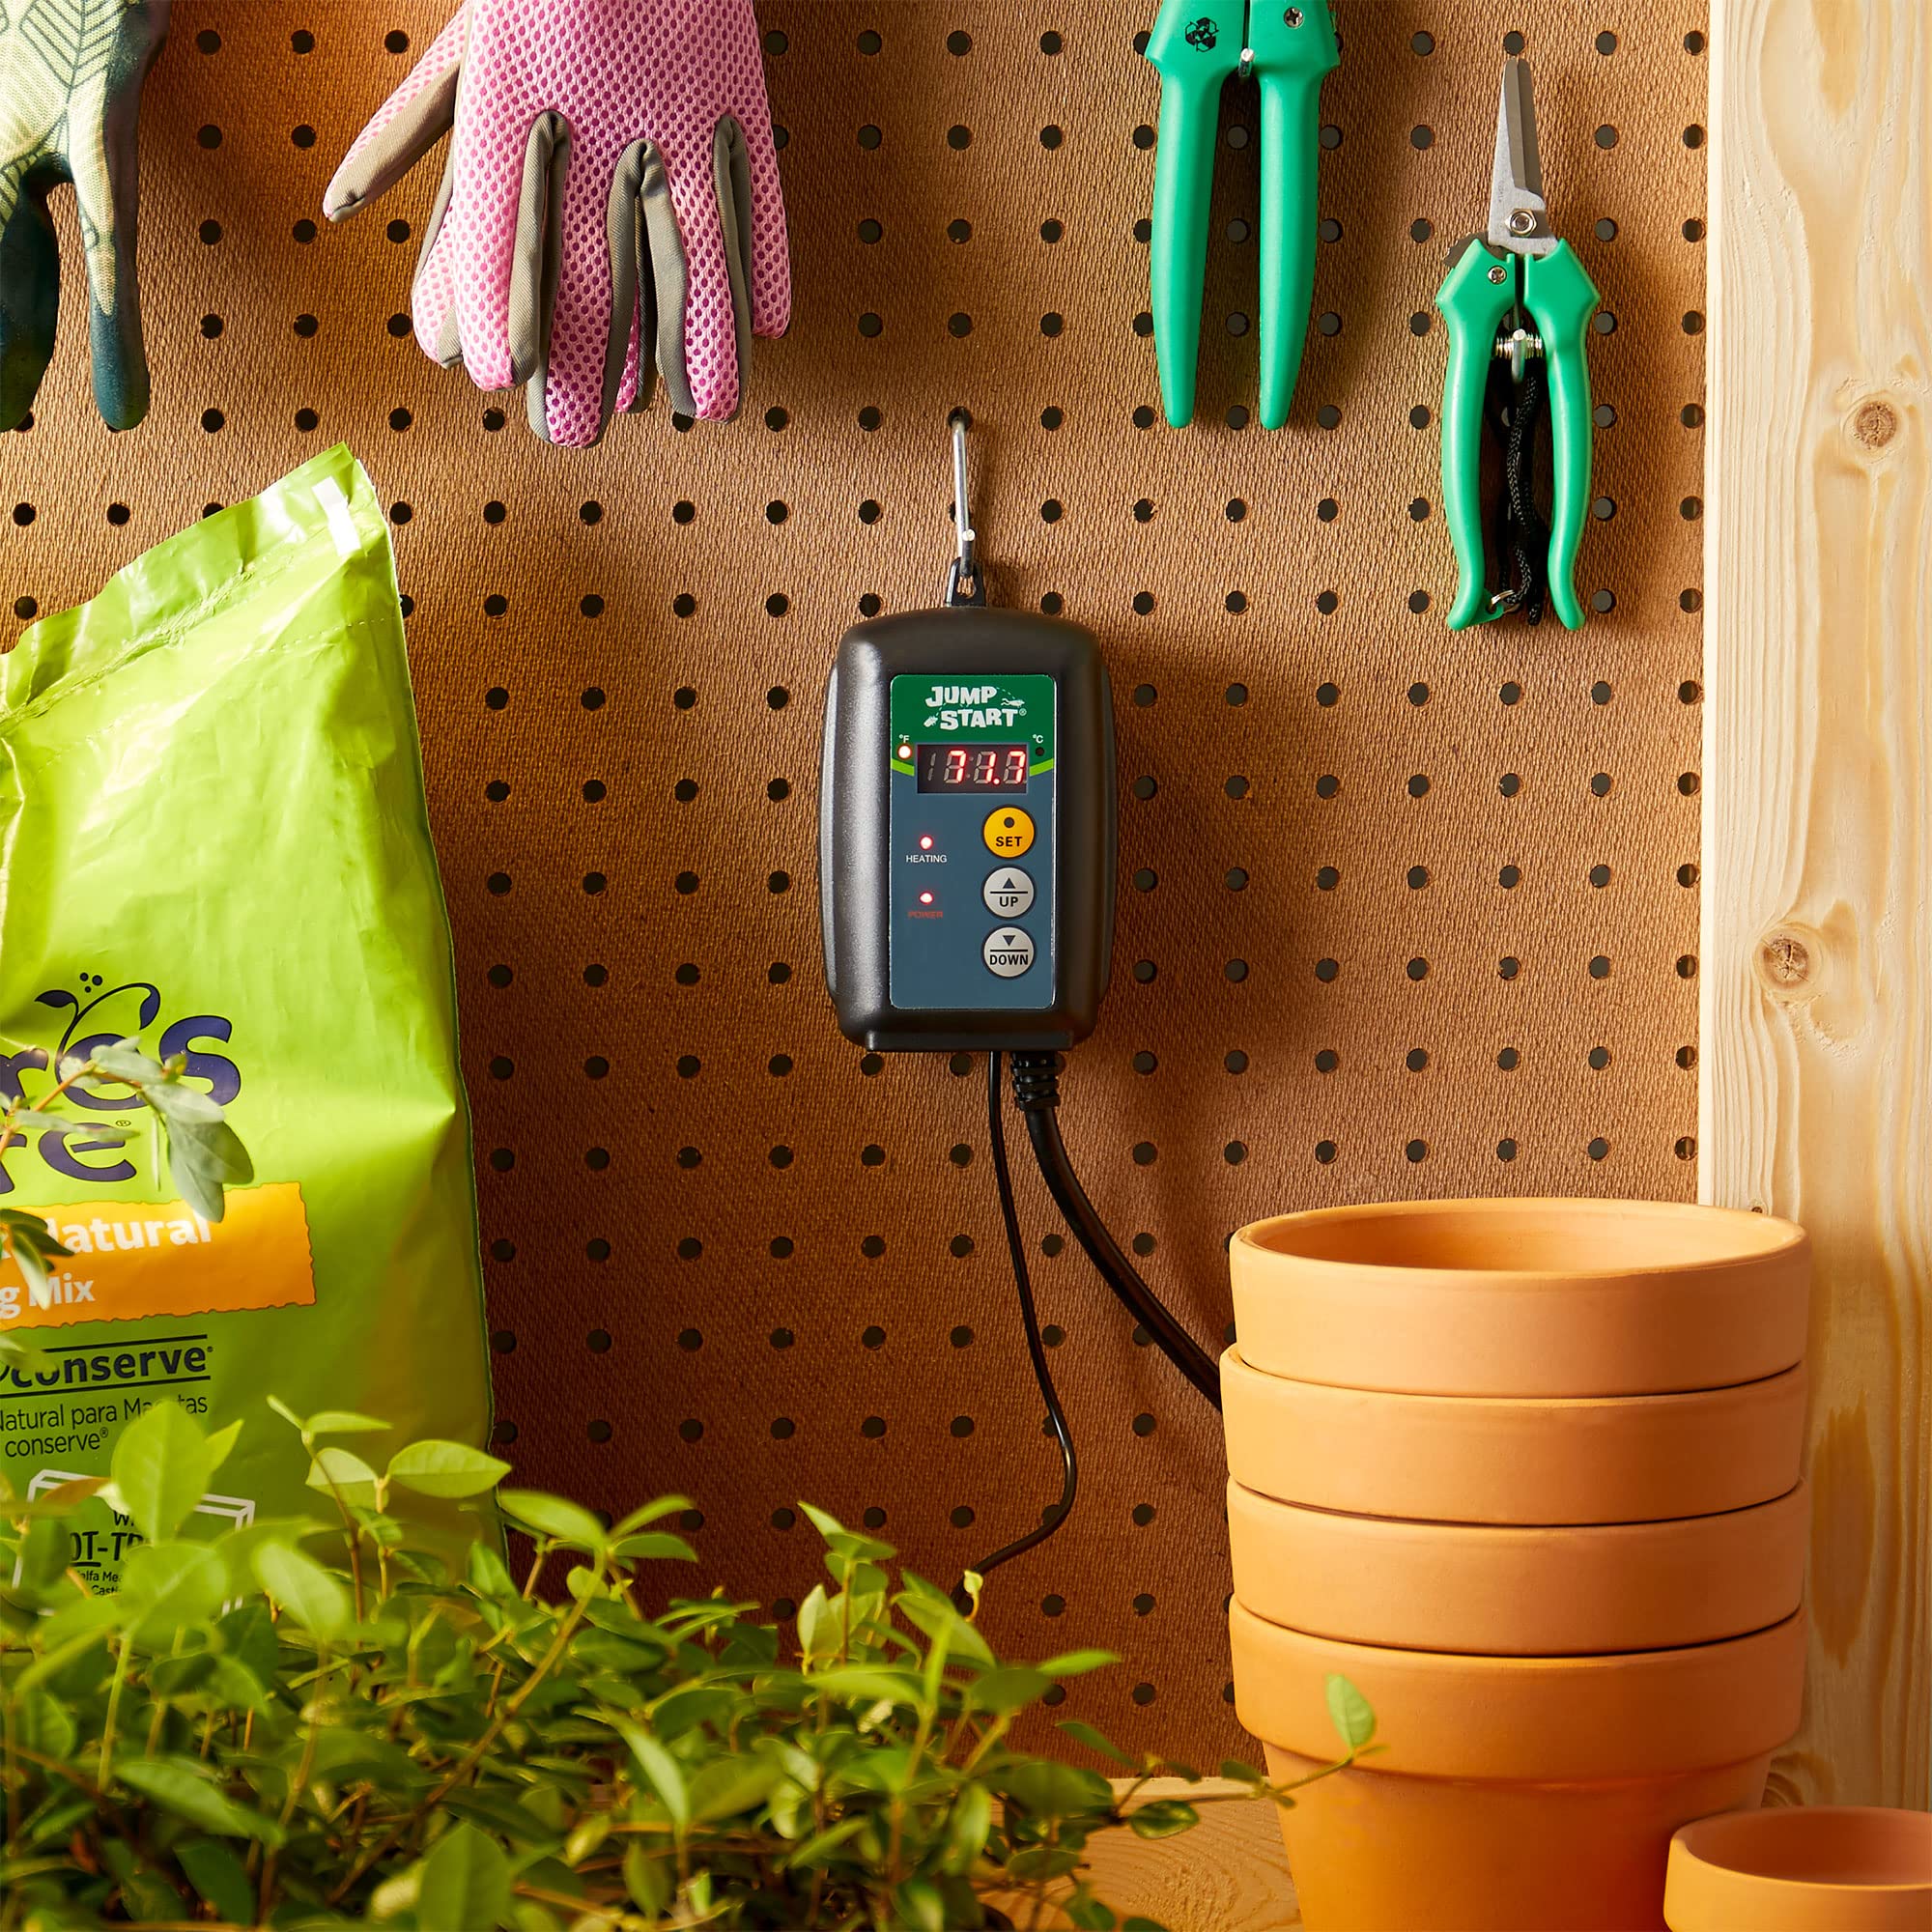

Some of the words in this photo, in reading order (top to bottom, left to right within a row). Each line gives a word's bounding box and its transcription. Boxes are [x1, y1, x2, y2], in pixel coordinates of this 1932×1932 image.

[924, 686, 997, 707] JUMP
[995, 836, 1023, 847] SET
[905, 854, 948, 864] HEATING
[999, 895, 1019, 907] UP
[908, 910, 944, 920] POWER
[989, 954, 1029, 966] DOWN
[71, 1404, 118, 1430] para
